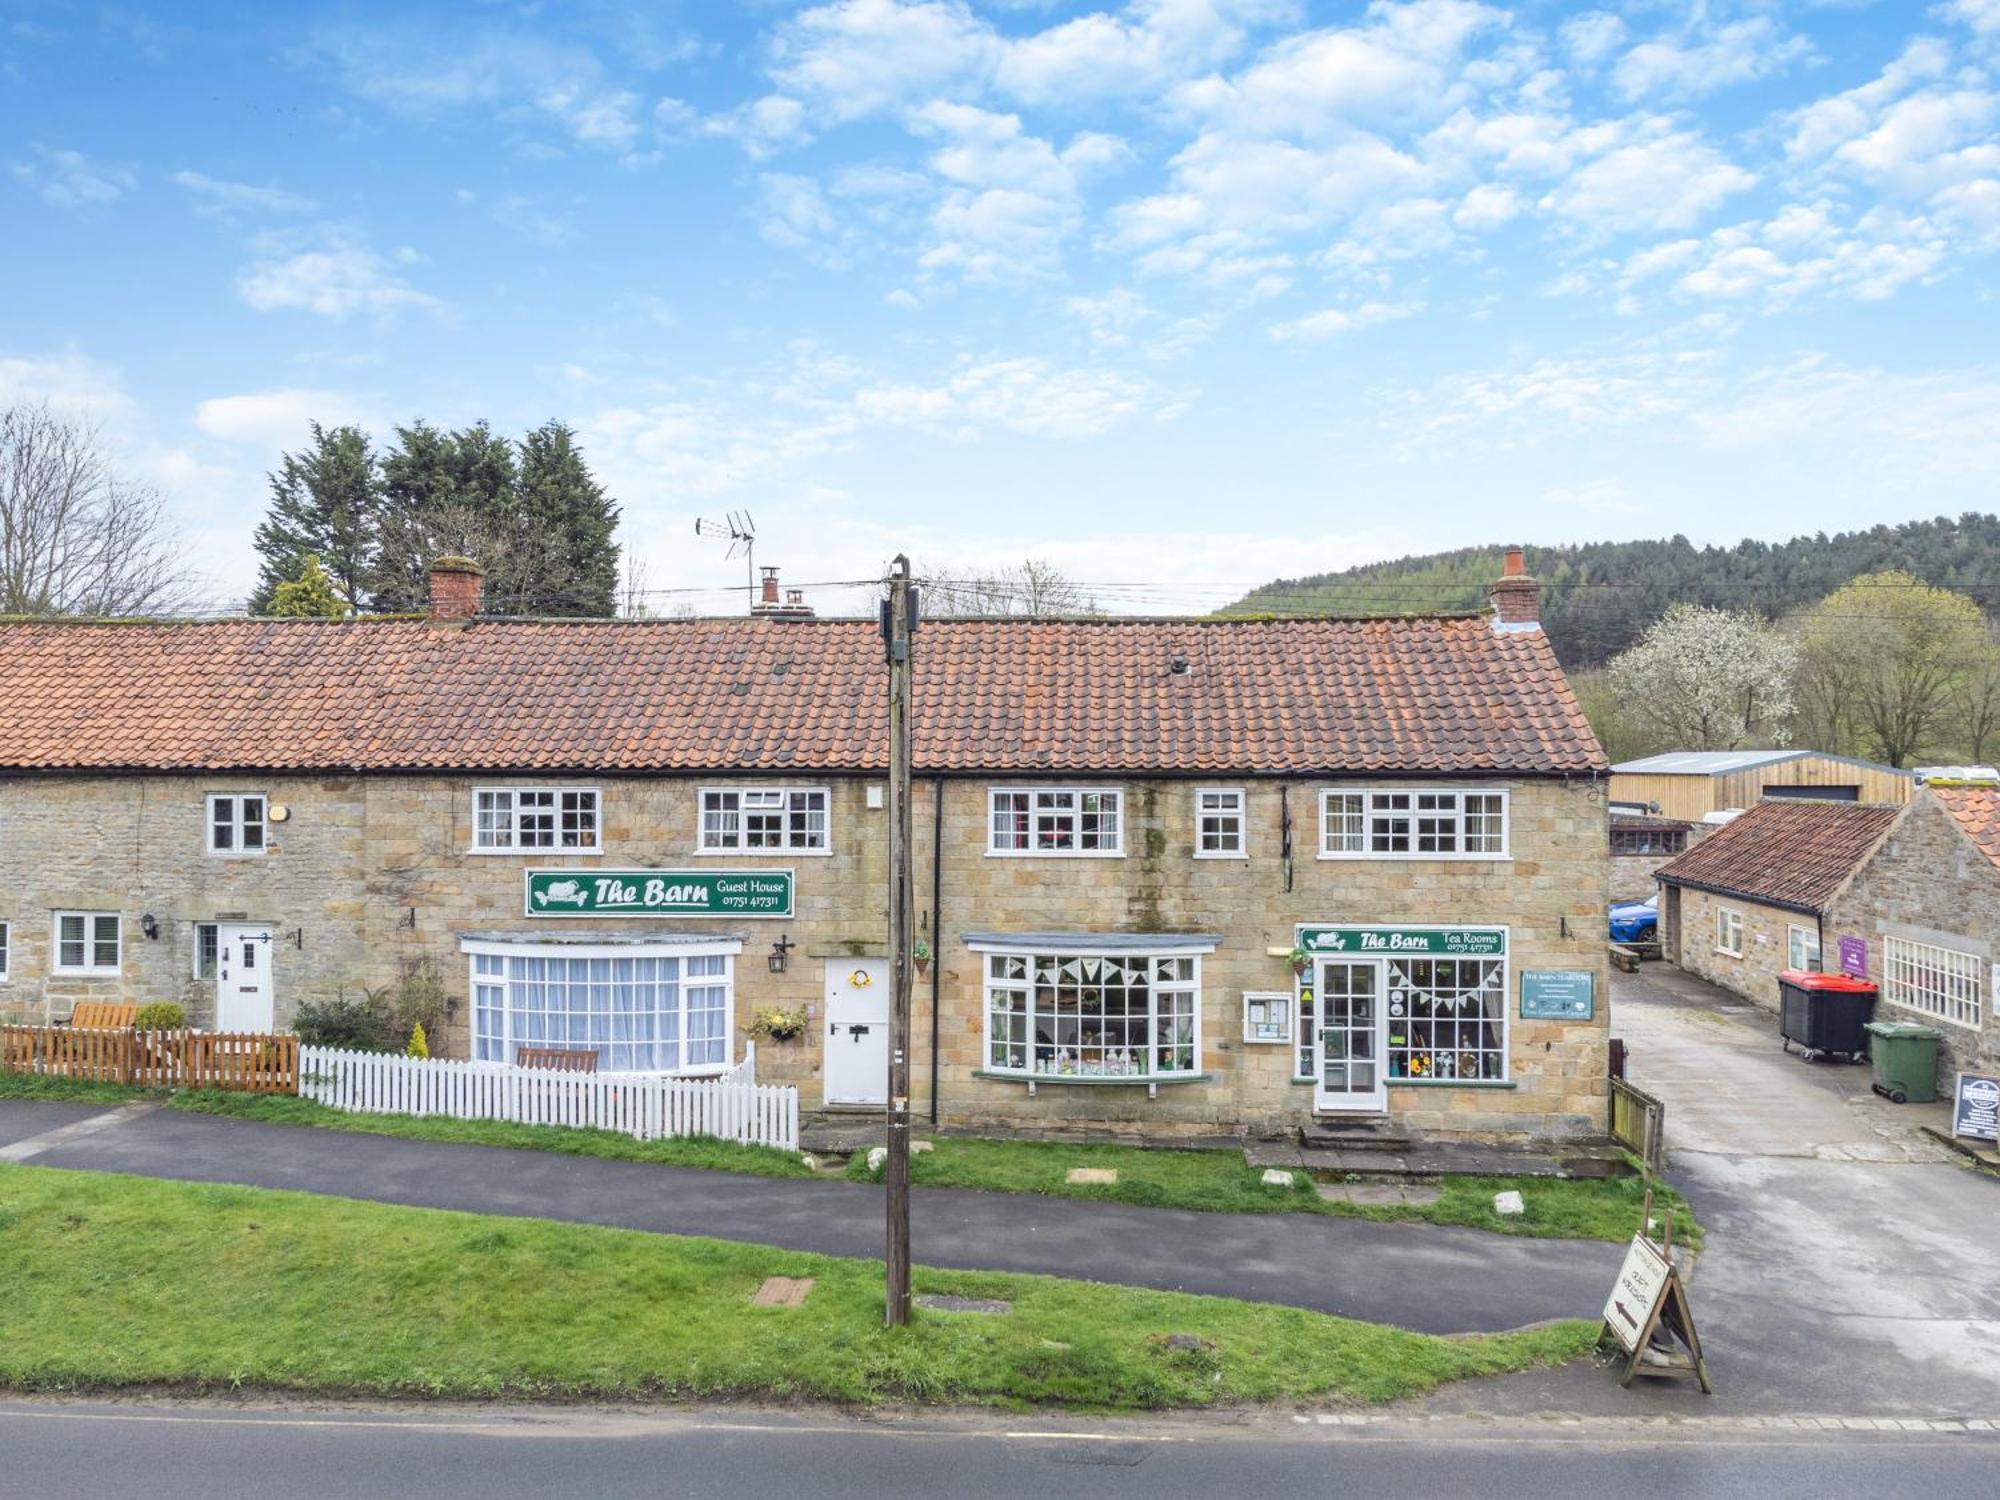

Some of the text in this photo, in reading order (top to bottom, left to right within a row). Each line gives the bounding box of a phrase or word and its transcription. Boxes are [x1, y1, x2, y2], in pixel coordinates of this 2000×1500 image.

[717, 880, 784, 893] Guest House
[595, 879, 709, 907] The Barn
[723, 897, 779, 908] 01751 417311
[1361, 933, 1429, 949] The Barn
[1442, 933, 1498, 943] Tea Rooms
[1447, 944, 1468, 953] 01751
